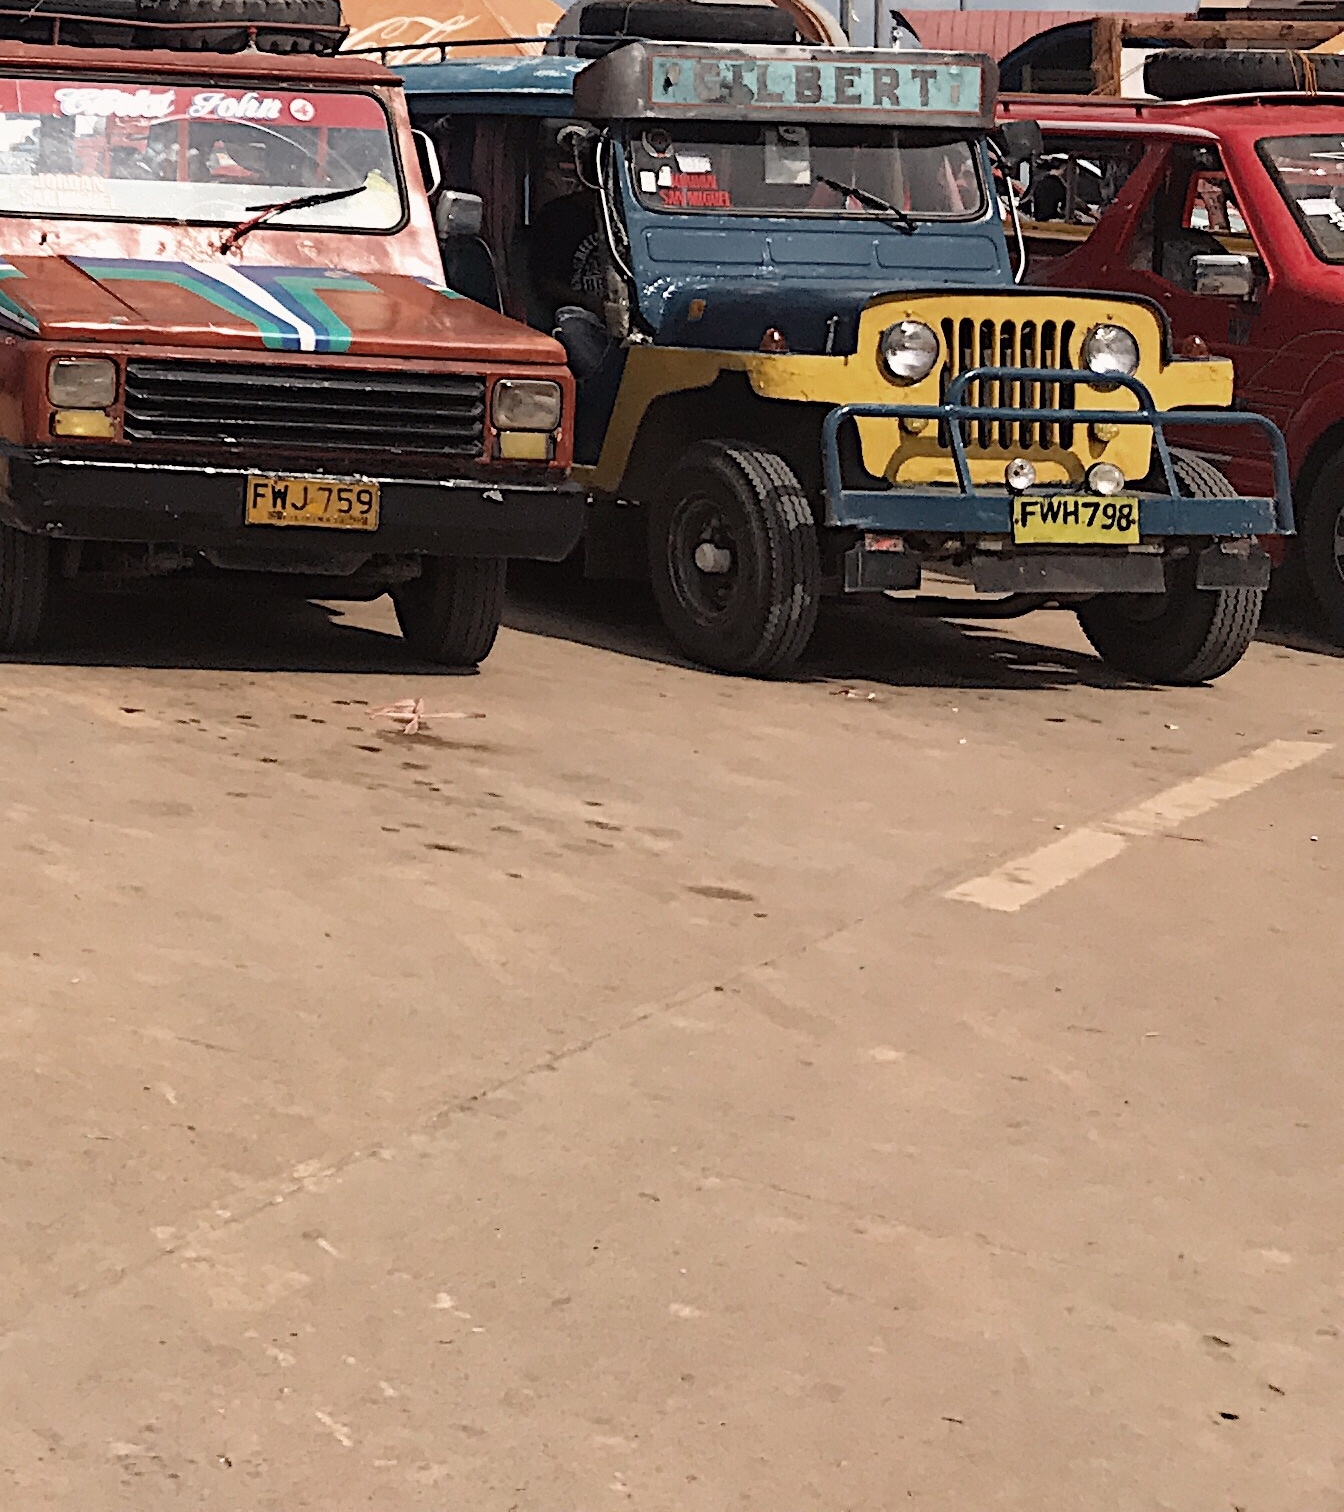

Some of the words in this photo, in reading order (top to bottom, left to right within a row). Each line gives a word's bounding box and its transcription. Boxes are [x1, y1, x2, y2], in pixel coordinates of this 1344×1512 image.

[188, 92, 284, 120] John
[35, 173, 106, 193] JORDAN
[252, 482, 309, 511] FWJ
[316, 486, 373, 515] 759
